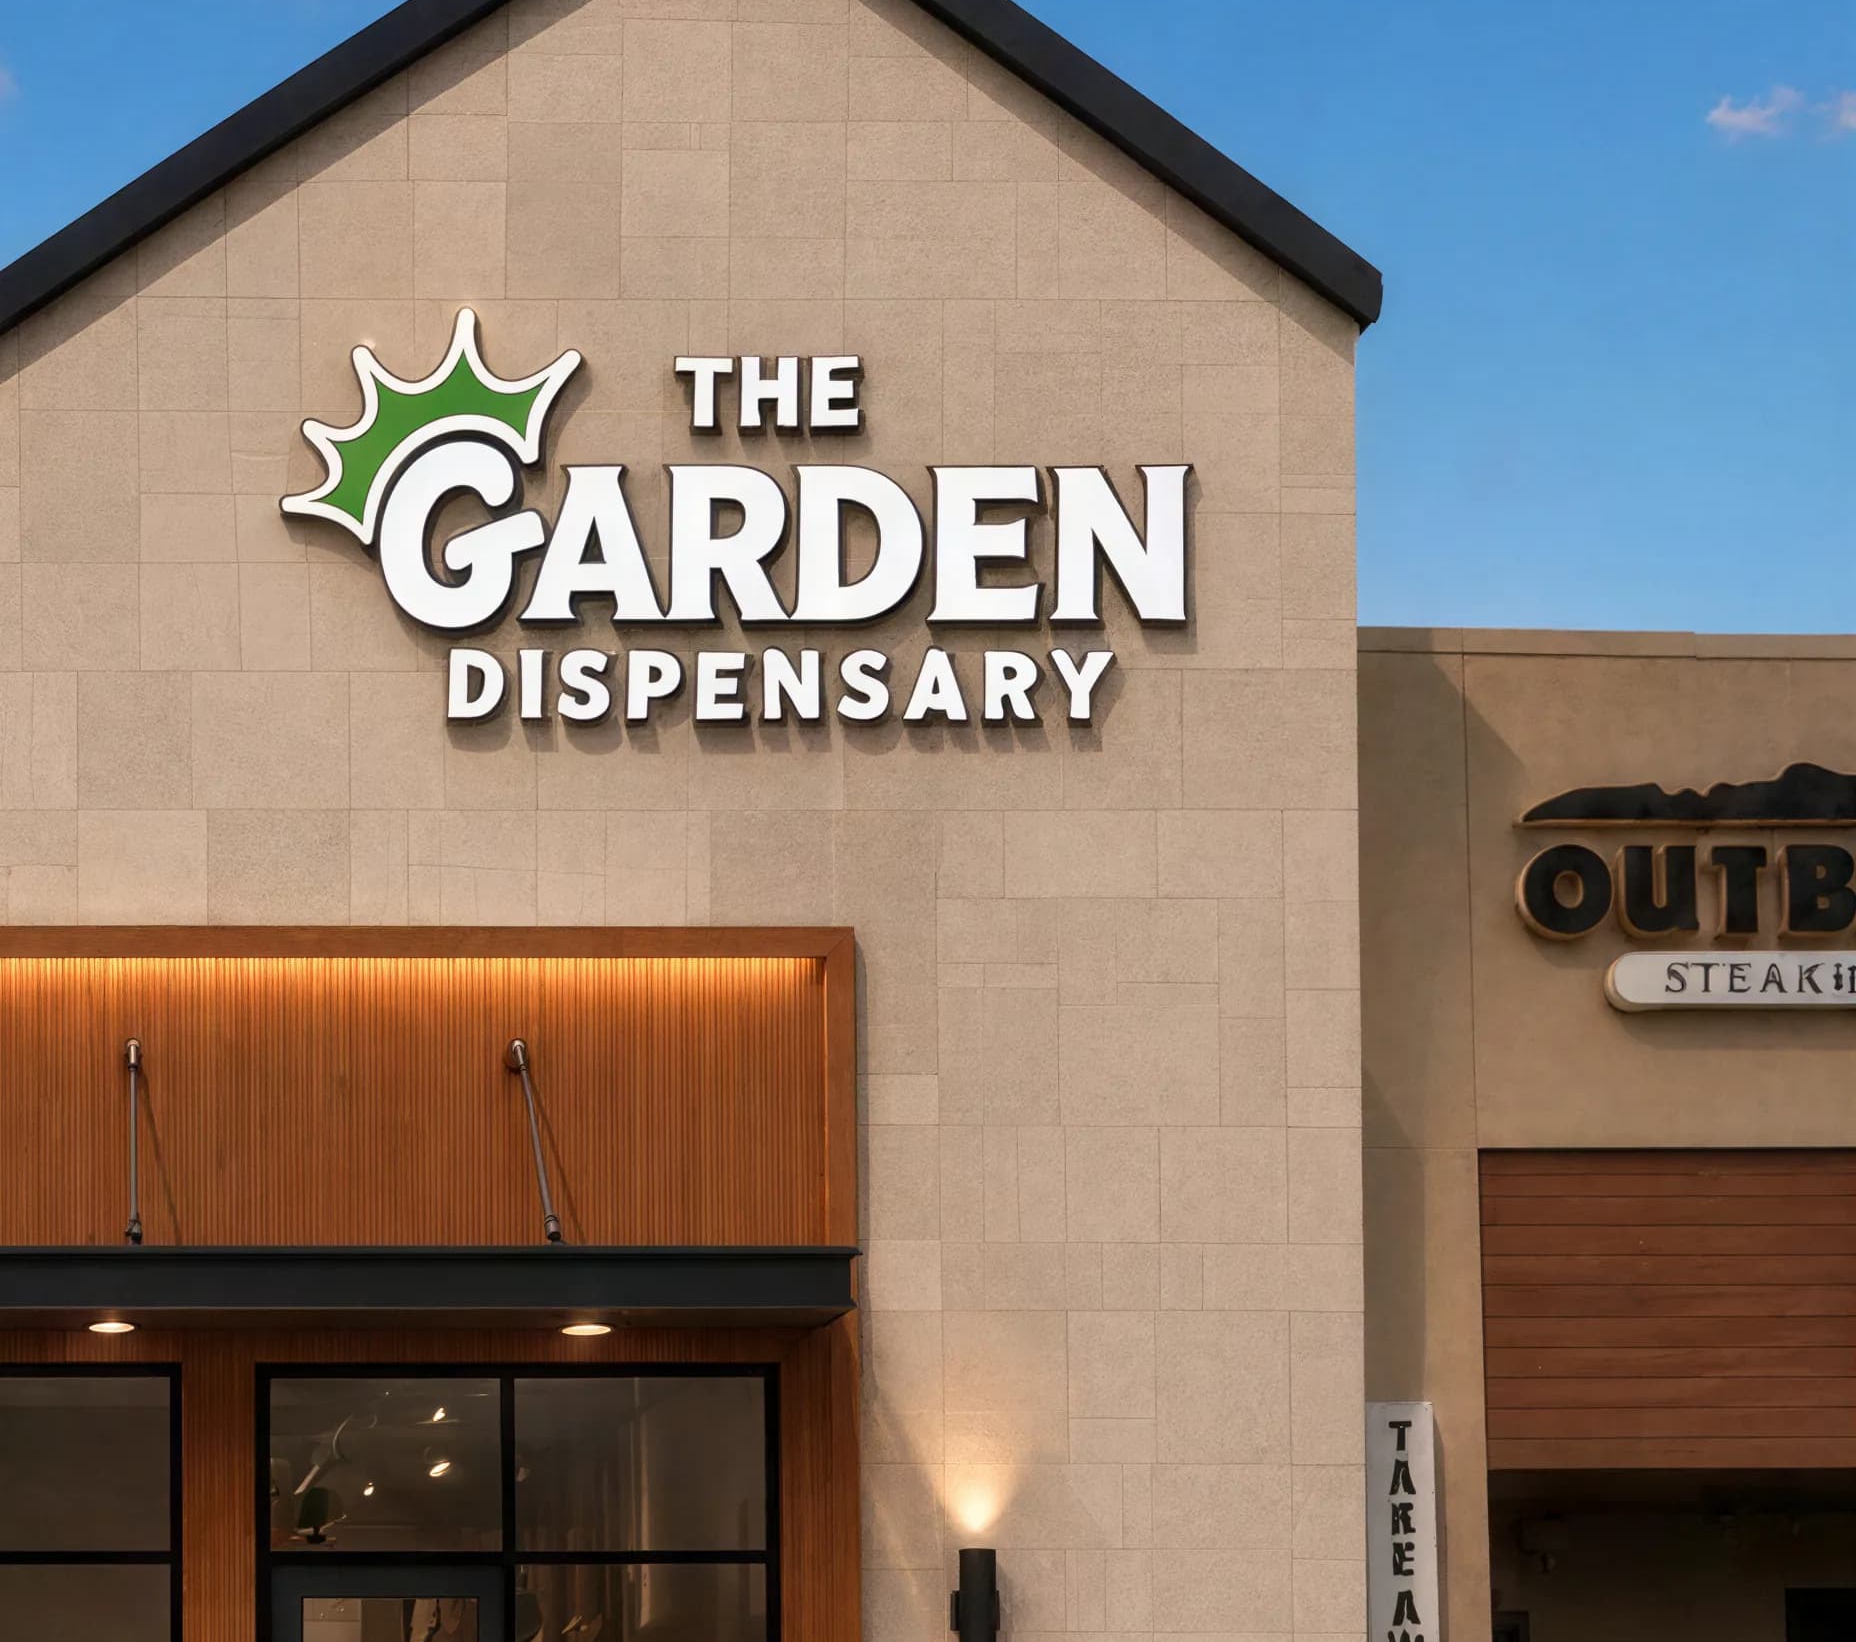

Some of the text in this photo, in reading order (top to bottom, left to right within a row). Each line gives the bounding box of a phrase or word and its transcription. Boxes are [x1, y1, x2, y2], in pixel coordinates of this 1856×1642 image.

[673, 355, 861, 428] THE
[378, 439, 1191, 629] GARDEN
[446, 647, 1115, 721] DISPENSARY
